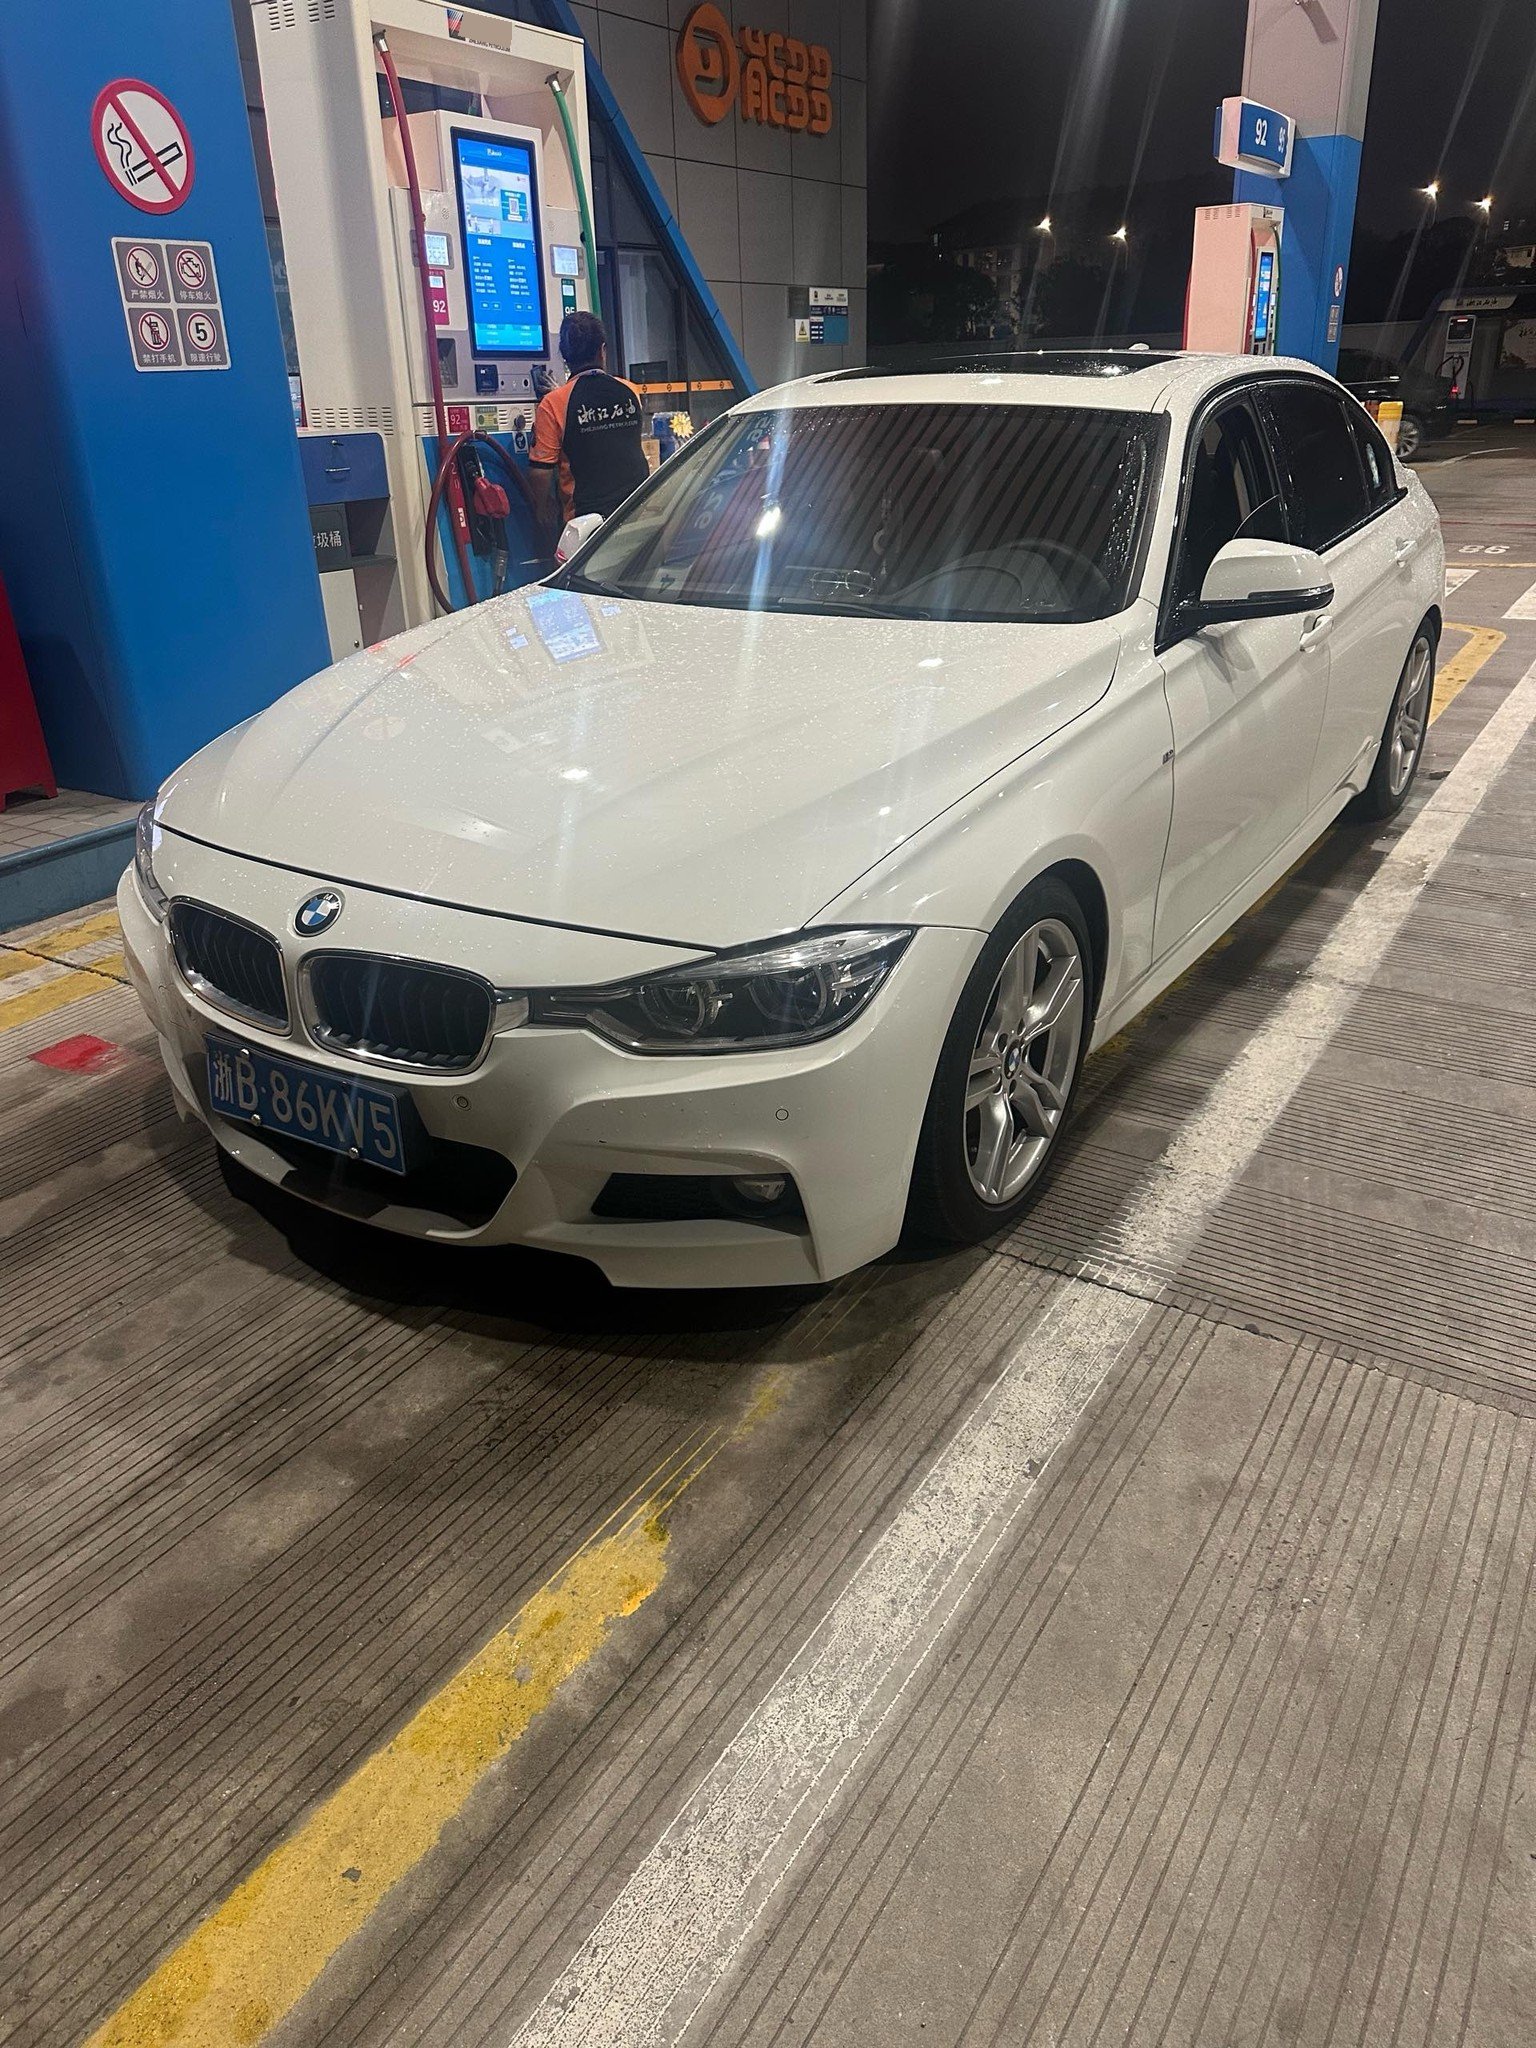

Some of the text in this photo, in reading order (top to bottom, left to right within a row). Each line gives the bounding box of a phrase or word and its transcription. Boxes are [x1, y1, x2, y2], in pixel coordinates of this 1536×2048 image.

[1255, 118, 1268, 146] 92
[1278, 126, 1286, 154] 95
[130, 289, 165, 300] 严禁烟火
[179, 290, 212, 301] 停车熄火
[432, 299, 446, 313] 92
[195, 322, 208, 341] 5
[142, 353, 177, 364] 禁打手机
[190, 353, 222, 363] 限速行驶
[577, 398, 636, 426] 浙江石油
[450, 413, 461, 425] 92
